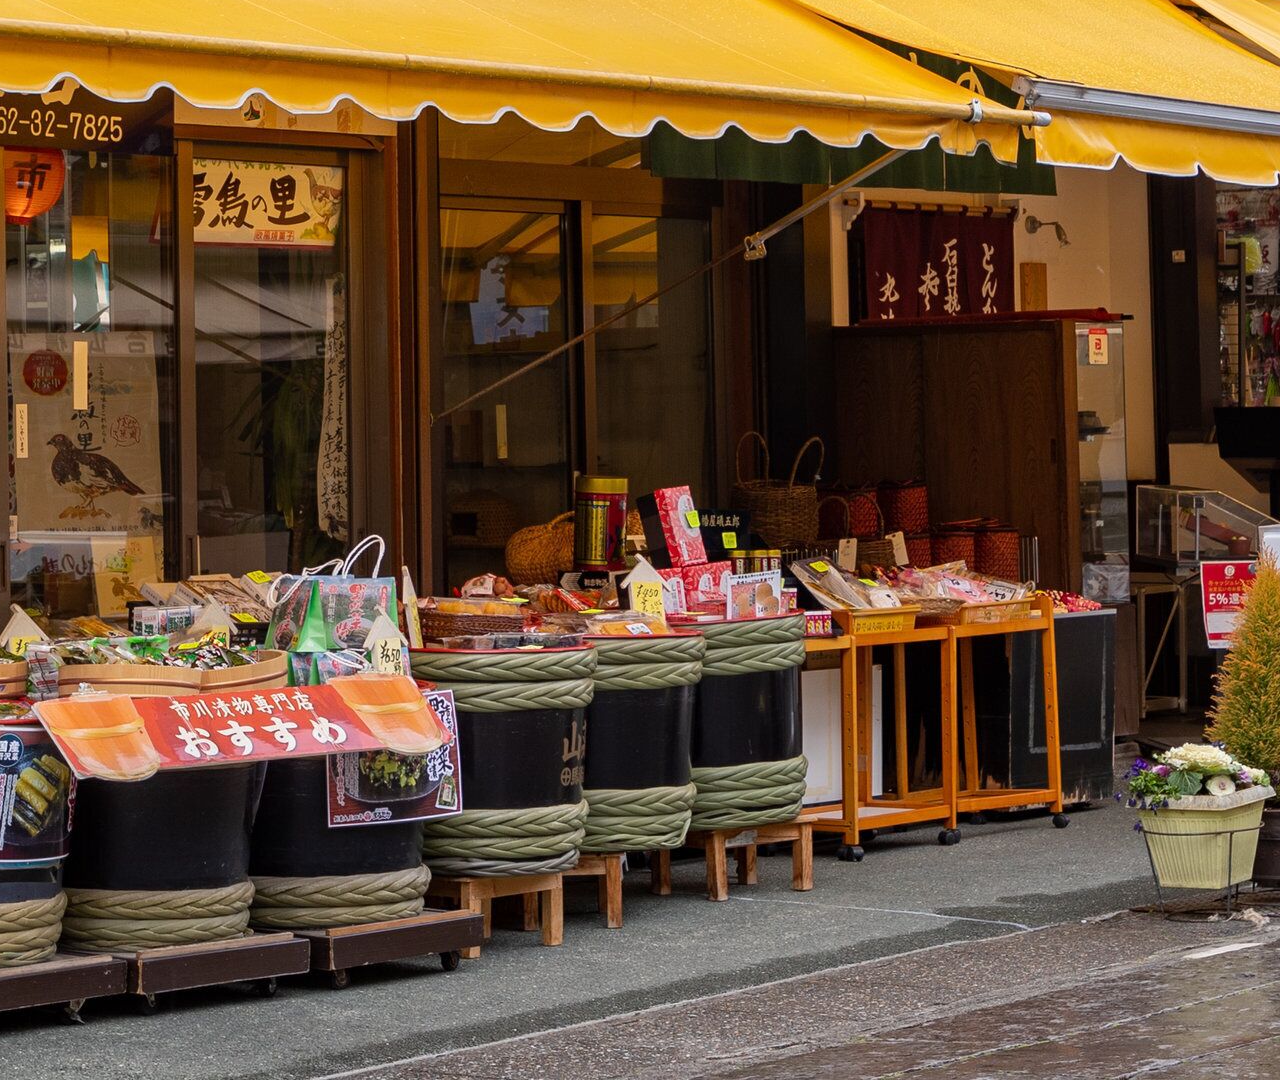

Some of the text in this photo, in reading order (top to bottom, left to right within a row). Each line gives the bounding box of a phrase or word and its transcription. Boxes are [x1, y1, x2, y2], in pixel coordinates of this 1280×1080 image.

[878, 272, 900, 319] 丸
[380, 640, 401, 664] ¥650
[168, 691, 316, 722] 市川漬物専門店
[174, 716, 349, 759] おすすめ
[428, 695, 455, 773] 野菜
